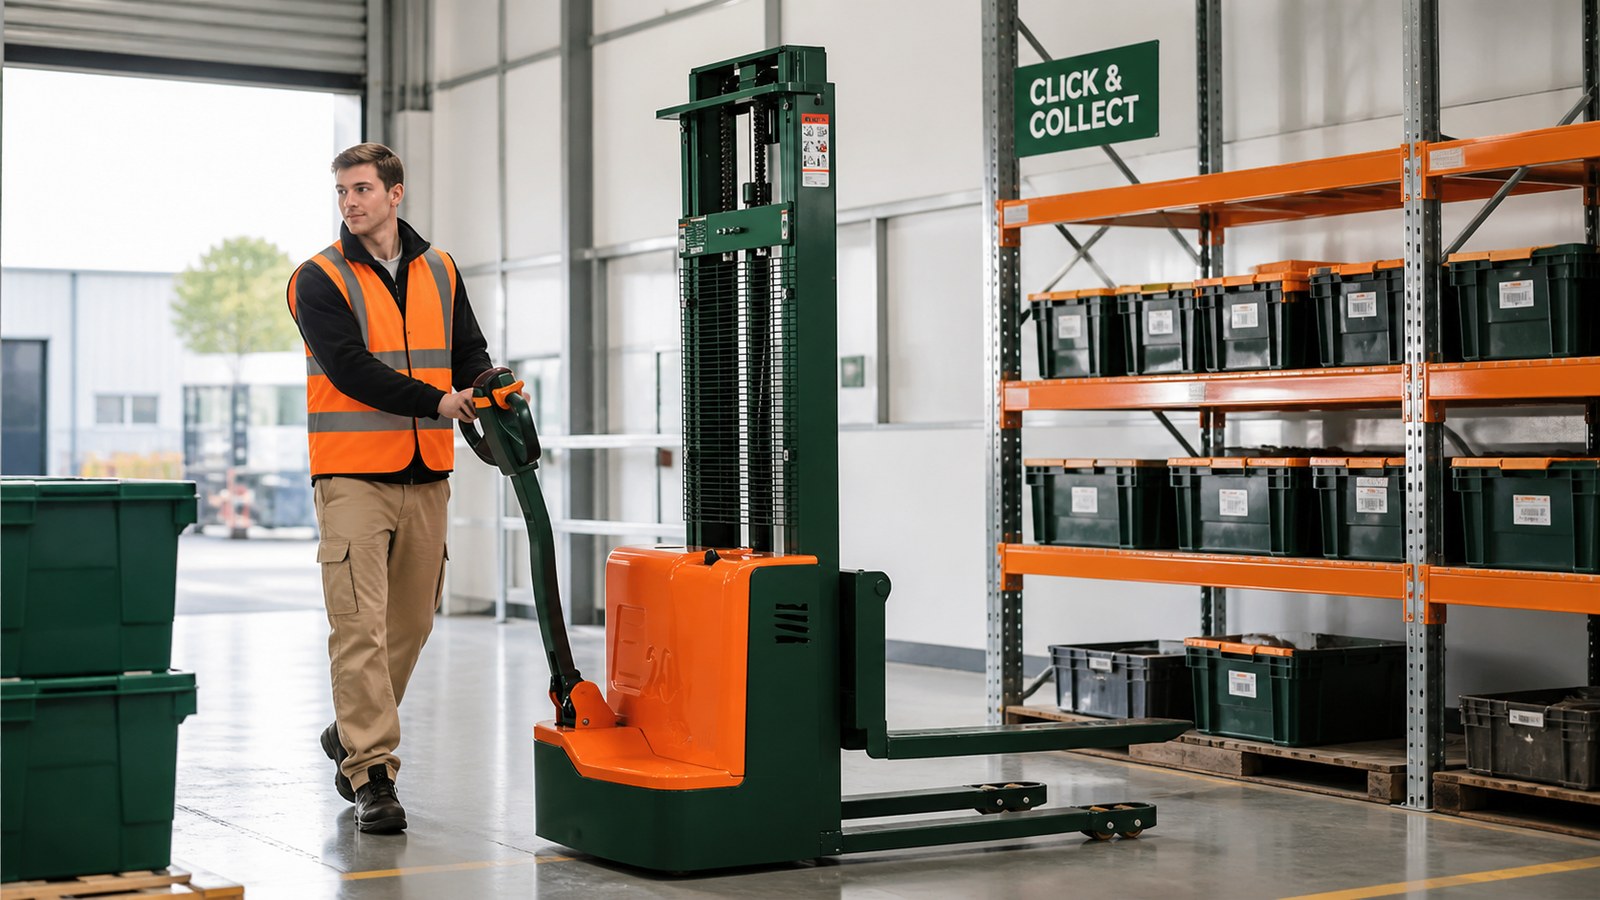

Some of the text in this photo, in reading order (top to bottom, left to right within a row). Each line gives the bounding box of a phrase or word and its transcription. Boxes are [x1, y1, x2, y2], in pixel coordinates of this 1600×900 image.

[1029, 64, 1122, 106] CLICK &
[1029, 94, 1139, 139] COLLECT
